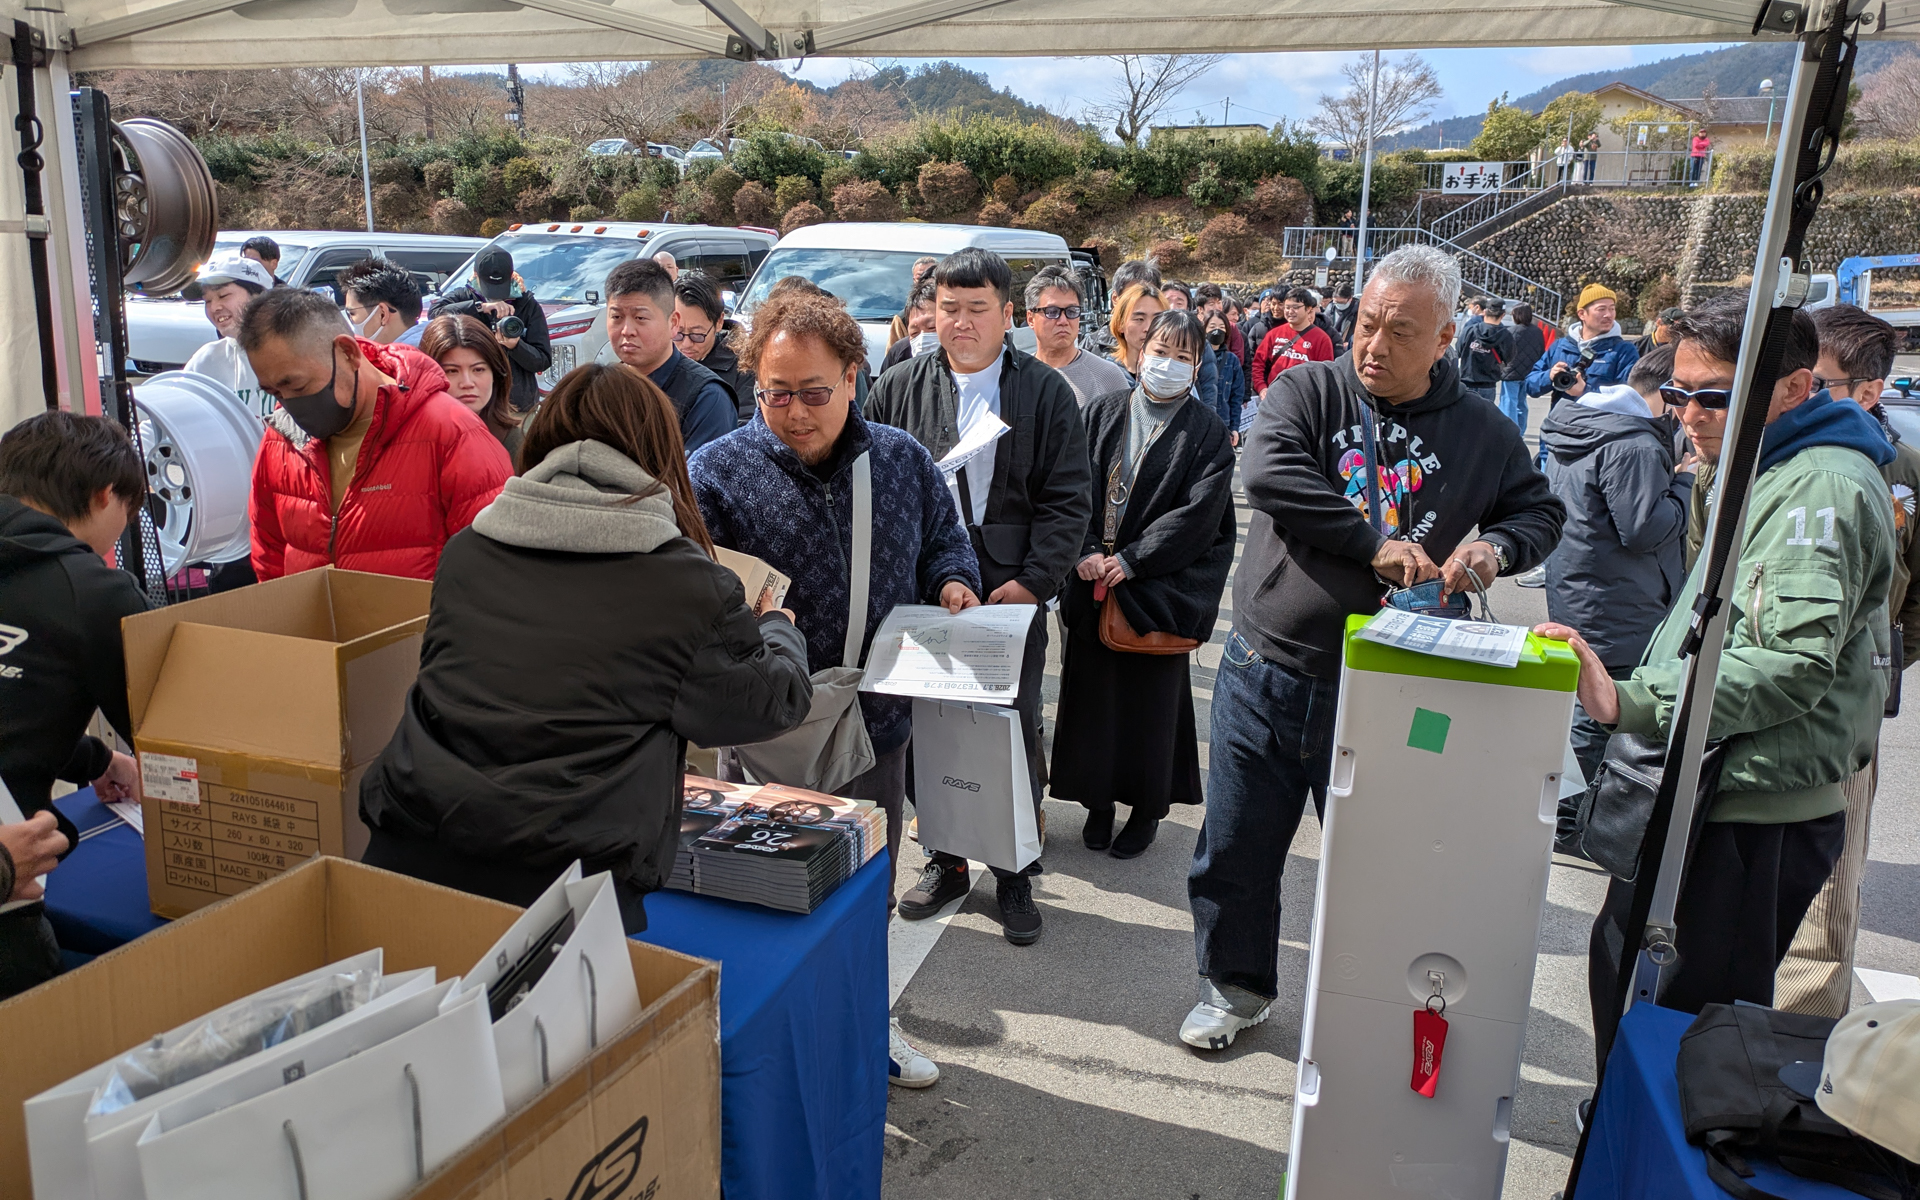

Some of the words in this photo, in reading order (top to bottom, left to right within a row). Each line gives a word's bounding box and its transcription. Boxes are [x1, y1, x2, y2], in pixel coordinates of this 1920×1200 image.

[1445, 172, 1499, 189] お手洗
[1786, 496, 1840, 549] 11
[942, 776, 981, 792] RAYS
[169, 802, 202, 815] 商品名
[232, 811, 258, 824] RAYS
[263, 816, 281, 830] 紙袋
[287, 820, 295, 832] 中
[230, 792, 295, 812] 2241051644616
[170, 818, 201, 832] サイズ
[227, 829, 242, 840] 260
[259, 834, 270, 845] 80
[287, 840, 303, 851] 320
[173, 835, 203, 851] 入り数
[247, 851, 285, 867] 100枚/箱
[172, 853, 207, 870] 原産国
[220, 863, 251, 878] MADE
[257, 870, 268, 881] IN
[1425, 1040, 1434, 1076] RAYS
